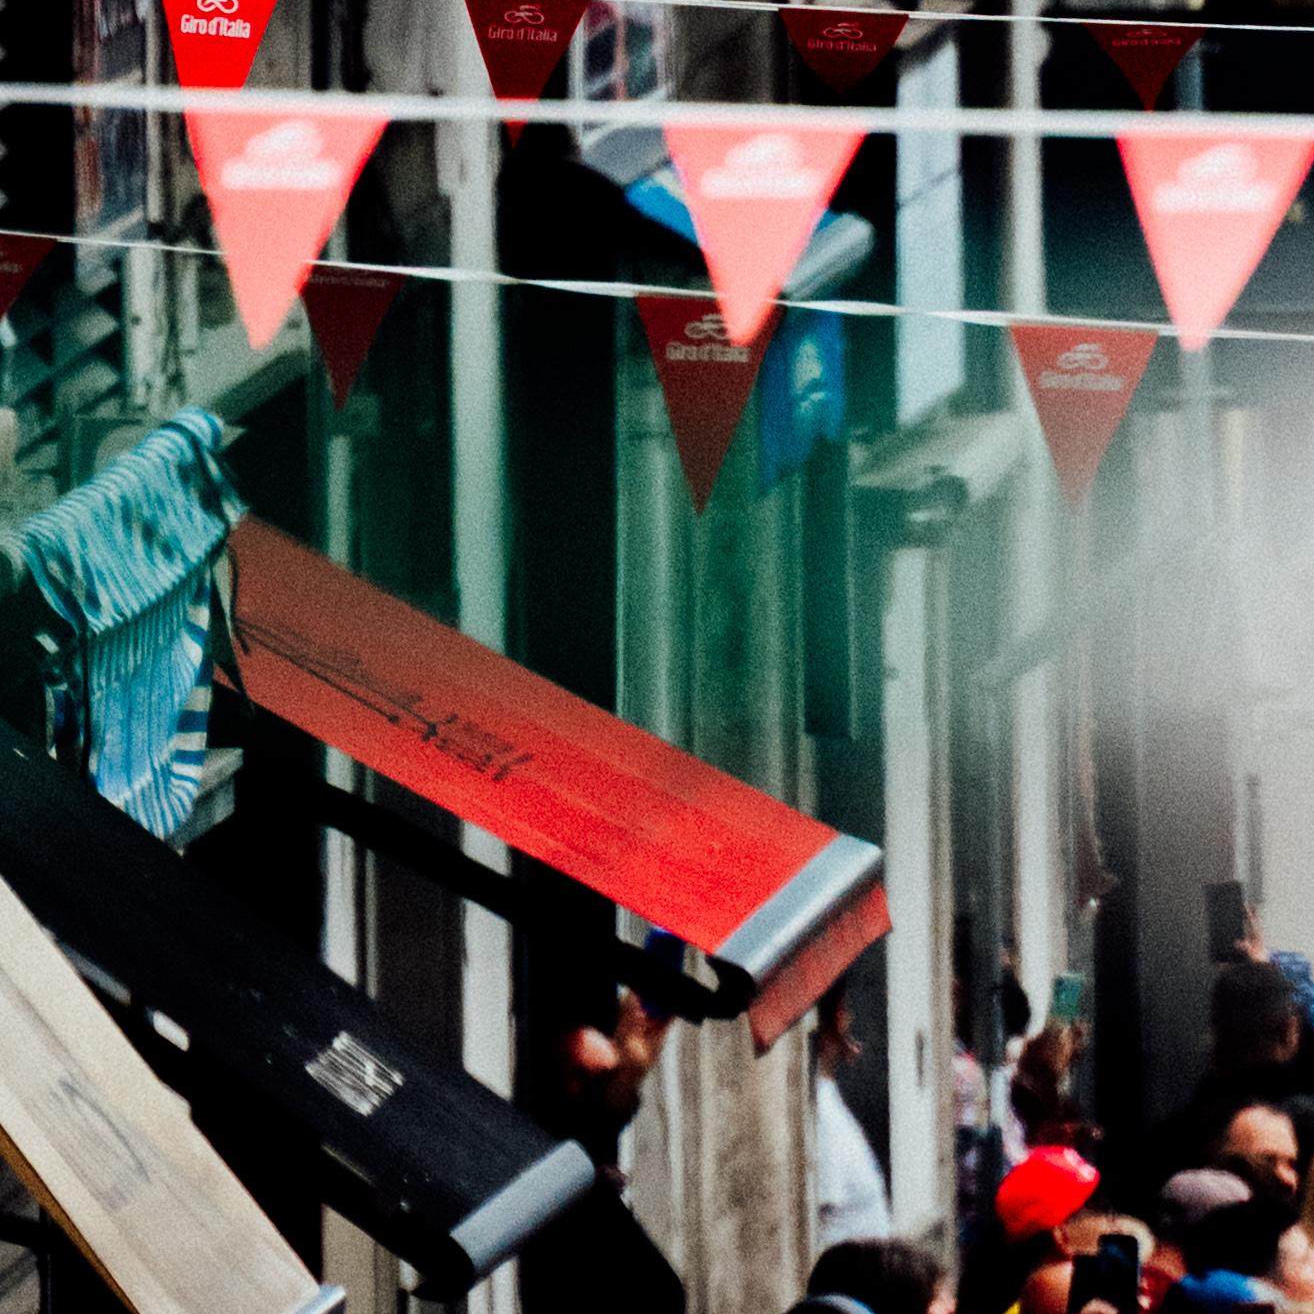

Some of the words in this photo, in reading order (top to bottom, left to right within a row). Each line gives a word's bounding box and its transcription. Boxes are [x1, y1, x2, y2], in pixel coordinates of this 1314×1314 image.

[181, 14, 207, 35] Giro
[210, 16, 250, 39] d'Italia
[488, 24, 513, 41] Giro
[517, 24, 558, 45] d'Italia
[807, 37, 833, 51] Giro
[836, 37, 877, 53] d'Italia
